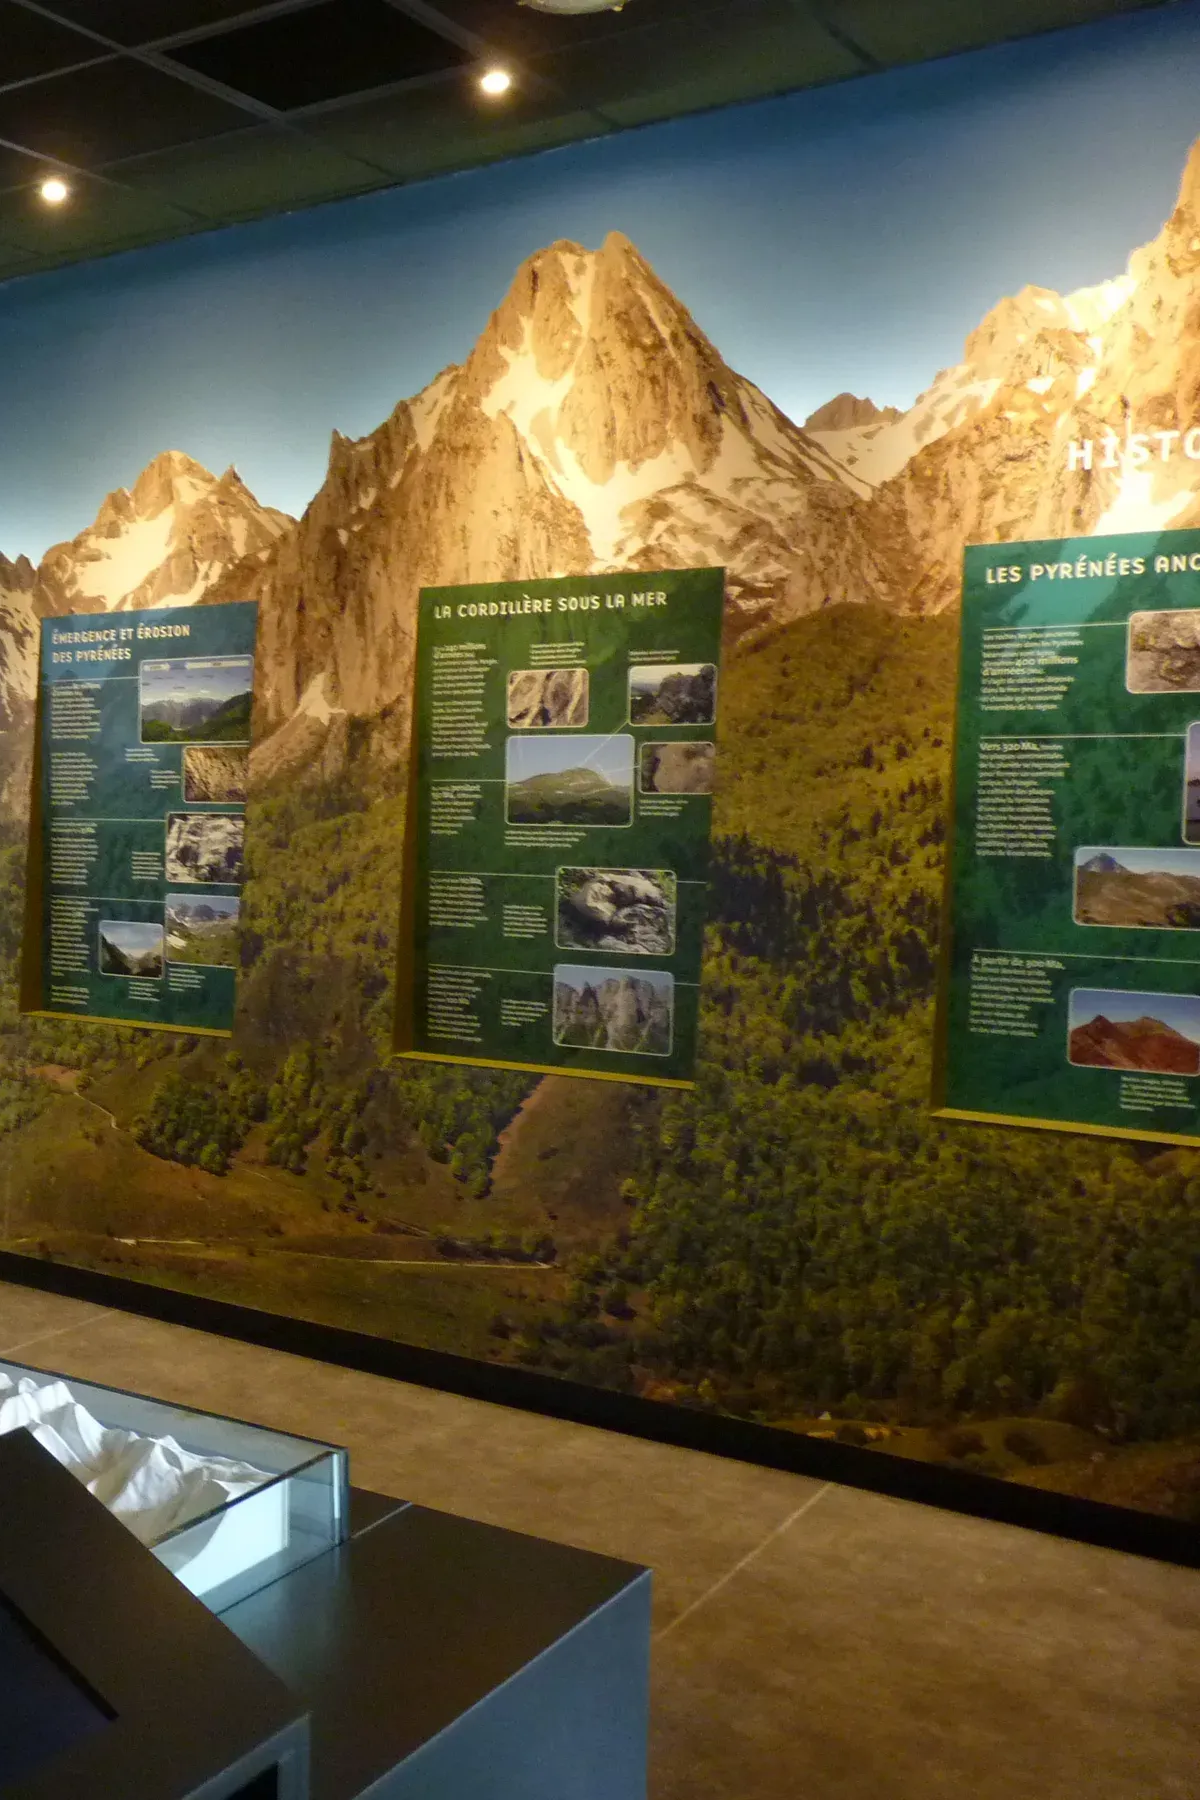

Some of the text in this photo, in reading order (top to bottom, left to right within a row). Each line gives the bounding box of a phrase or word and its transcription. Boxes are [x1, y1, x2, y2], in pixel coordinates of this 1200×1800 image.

[986, 566, 1022, 584] LES
[1030, 552, 1145, 581] PYRÉNÉES
[434, 591, 668, 619] LA CORDILLÈRE SOUS LA MER
[52, 622, 191, 645] ÉMERGENCE ET ÉROSION
[52, 644, 132, 663] DES PYRÉNÉES
